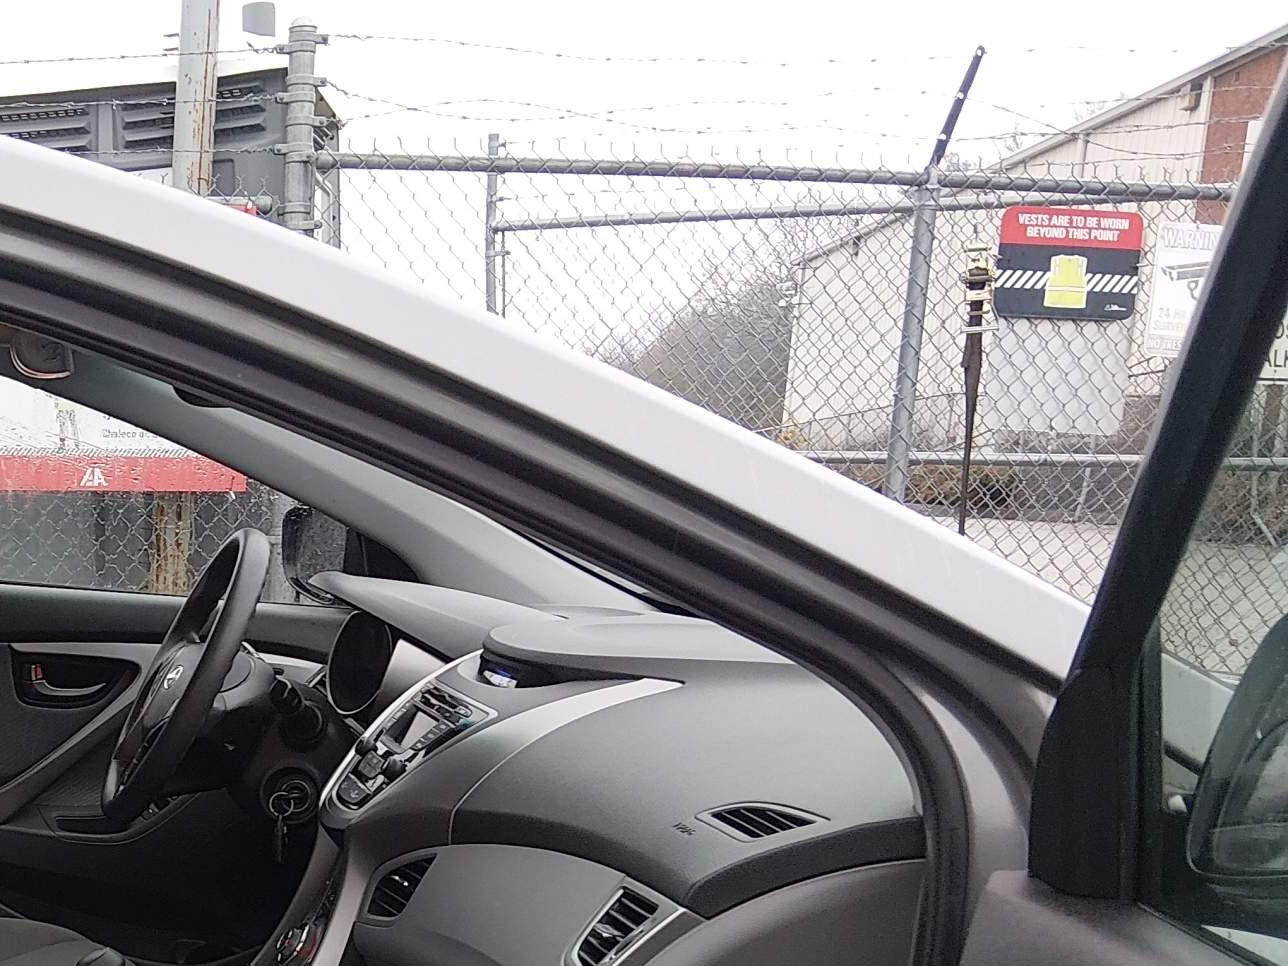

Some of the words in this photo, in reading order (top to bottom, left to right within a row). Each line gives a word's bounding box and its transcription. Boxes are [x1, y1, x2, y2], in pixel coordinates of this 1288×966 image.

[1018, 213, 1049, 225] VESTS
[1050, 214, 1071, 226] ARE
[1071, 215, 1085, 227] TO
[1086, 216, 1099, 228] BE
[1100, 217, 1129, 230] WORN
[1026, 226, 1066, 238] BEYOND
[1067, 227, 1089, 240] THIS
[1091, 229, 1120, 241] POINT
[1163, 228, 1220, 250] WARNIN
